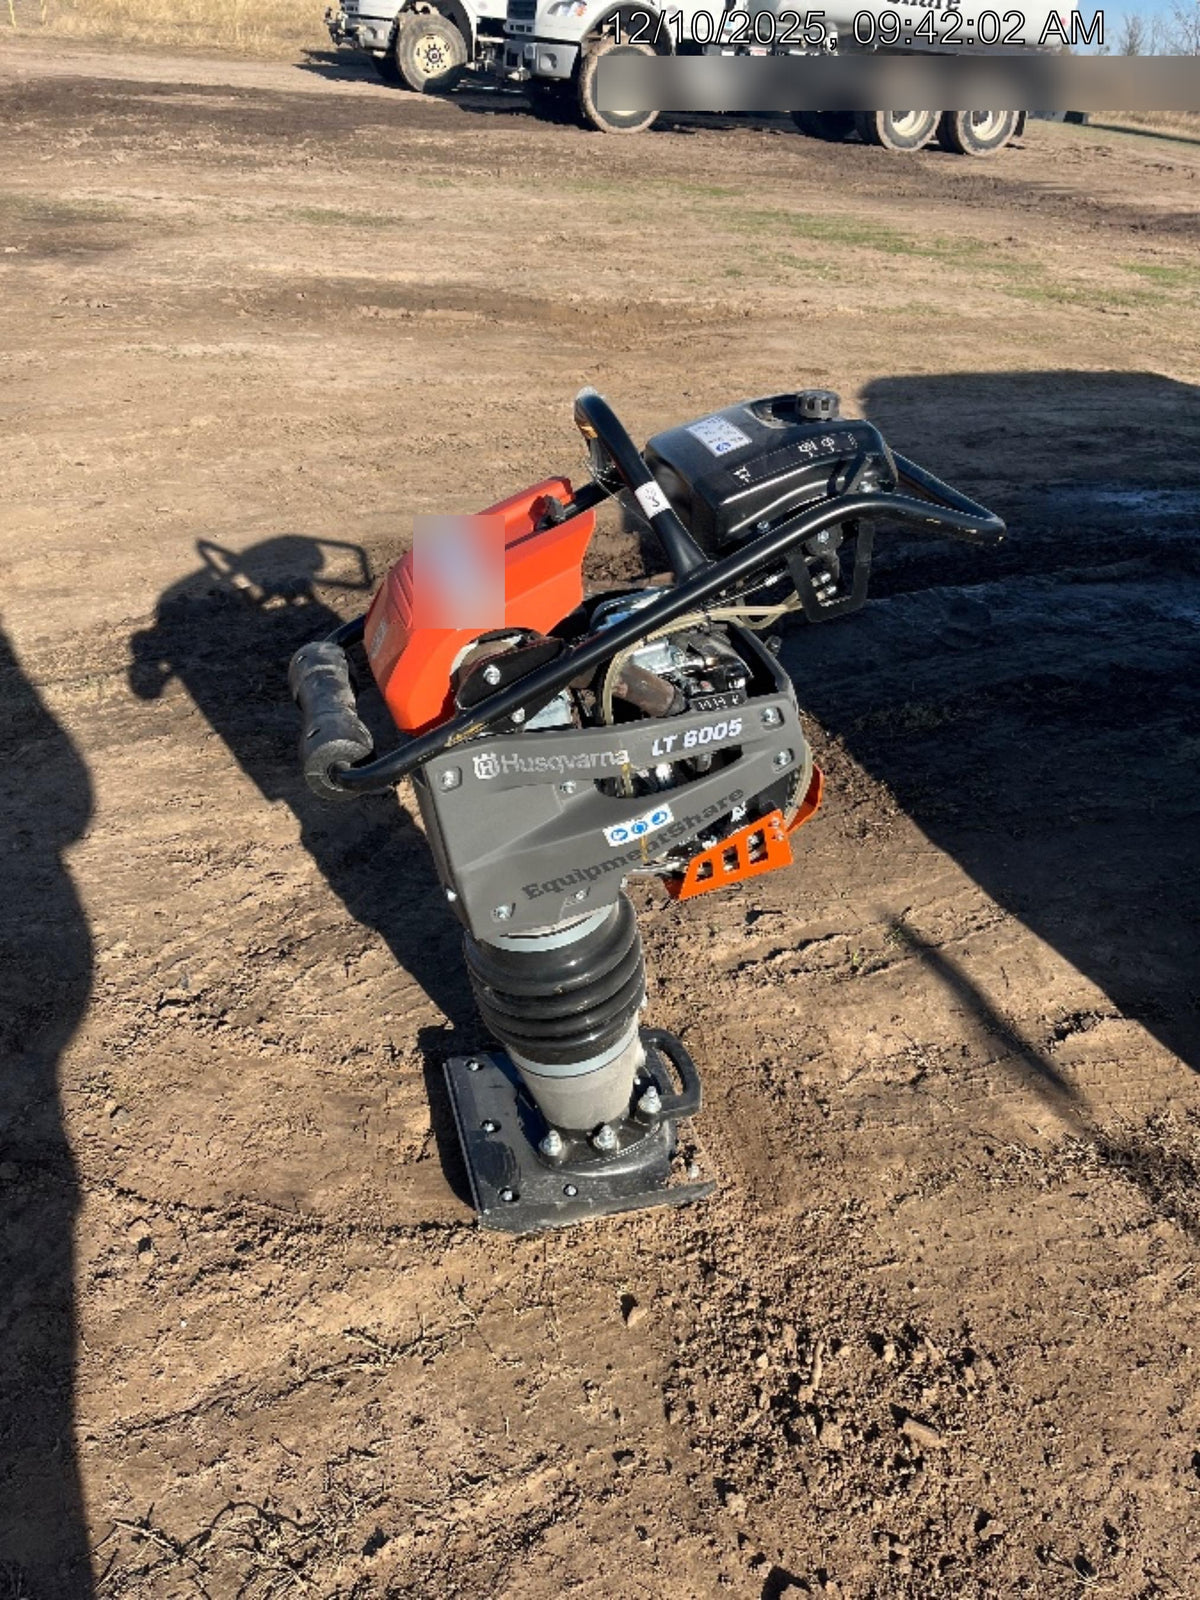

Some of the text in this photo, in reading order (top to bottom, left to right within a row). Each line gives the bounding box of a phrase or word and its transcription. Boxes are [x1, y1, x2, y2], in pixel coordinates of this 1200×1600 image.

[651, 718, 743, 757] LT 6005
[501, 749, 630, 776] Husqvarna
